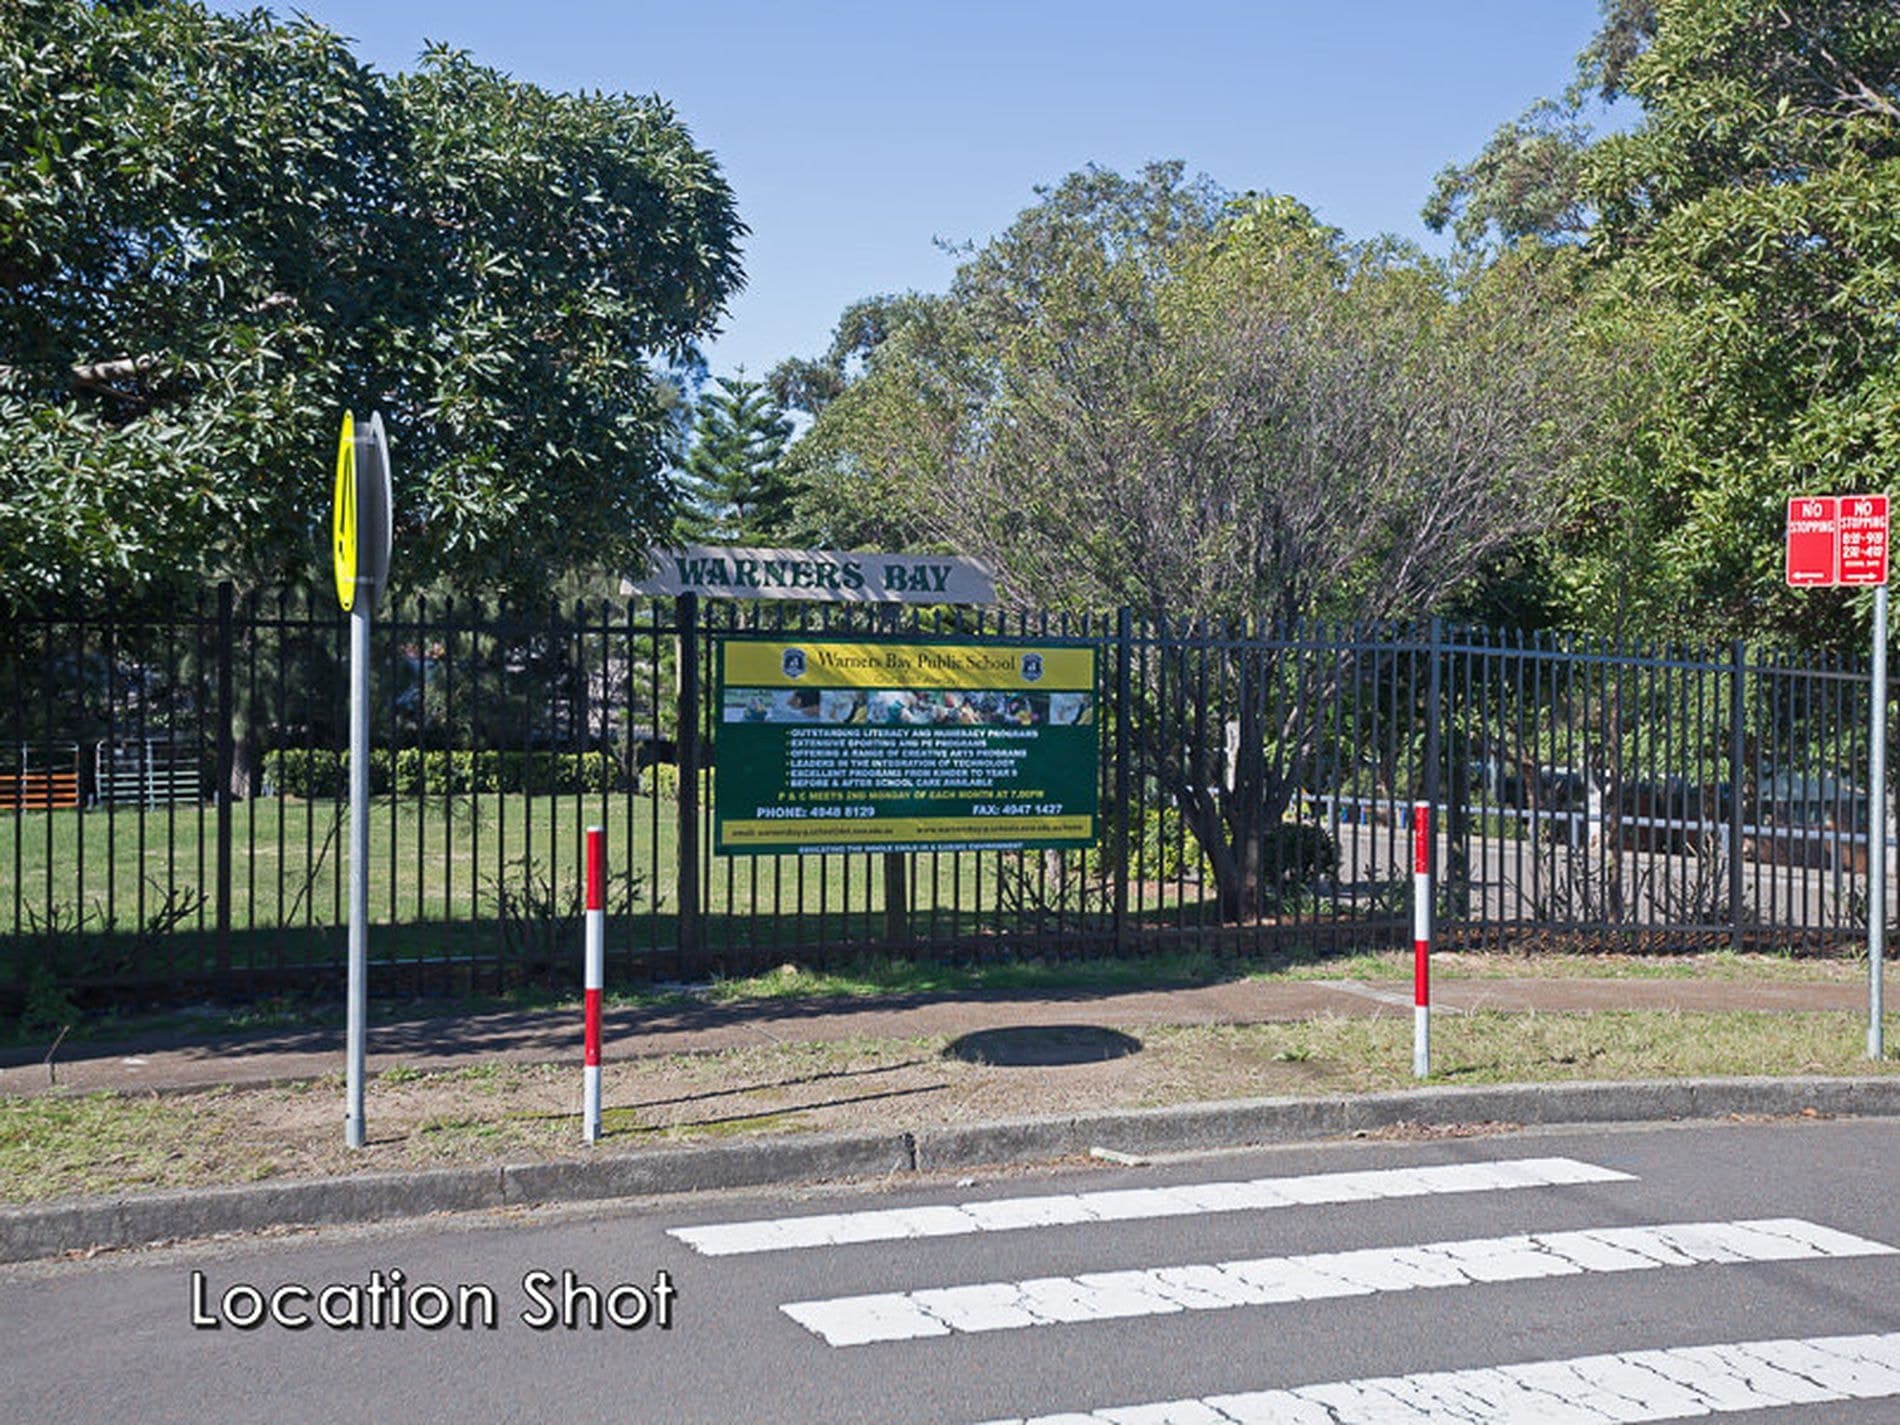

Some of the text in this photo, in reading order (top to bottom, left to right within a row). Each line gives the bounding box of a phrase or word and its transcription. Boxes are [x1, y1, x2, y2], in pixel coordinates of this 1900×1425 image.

[1801, 503, 1823, 517] NO
[1854, 501, 1873, 516] NO
[1789, 521, 1835, 533] STOPPING
[1840, 516, 1885, 529] STOPPING
[675, 556, 953, 592] WARNERS BAY
[818, 651, 1015, 672] Warners Bay Public School
[790, 728, 860, 738] OUTSTANDING
[863, 728, 909, 738] LITERACY
[911, 728, 932, 738] AND
[987, 728, 1039, 738] PROGRAMS
[847, 739, 896, 748] SPORTING
[898, 739, 919, 748] AND
[920, 739, 933, 748] PE
[935, 739, 987, 748] PROGRAMS
[790, 749, 839, 758] OFFERING
[842, 749, 849, 758] A
[886, 749, 899, 758] OF
[902, 749, 947, 758] CREATIVE
[950, 749, 975, 758] ARTS
[976, 749, 1027, 758] PROGRAMS
[790, 759, 1016, 768] LEADERS IN THE INTEGRATION OF TECHNOLOGY
[790, 769, 846, 778] EXCELLENT
[848, 769, 902, 778] PROGRAMS
[904, 769, 931, 778] FROM
[933, 769, 968, 778] KINDER
[971, 769, 983, 778] TO
[985, 769, 1010, 778] YEAR
[790, 779, 829, 788] BEFORE
[841, 779, 873, 788] AFTER
[875, 779, 914, 788] SCHOOL
[916, 779, 941, 788] CARE
[777, 792, 786, 801] P
[798, 791, 806, 800] C
[809, 791, 844, 800] MEETS
[868, 790, 911, 799] MONDAY
[913, 790, 926, 799] OF
[929, 790, 955, 799] EACH
[958, 790, 994, 799] MONTH
[996, 790, 1008, 799] AT
[756, 806, 876, 818] PHONE: 4948 8129
[972, 803, 1064, 816] FAX: 4947 1427
